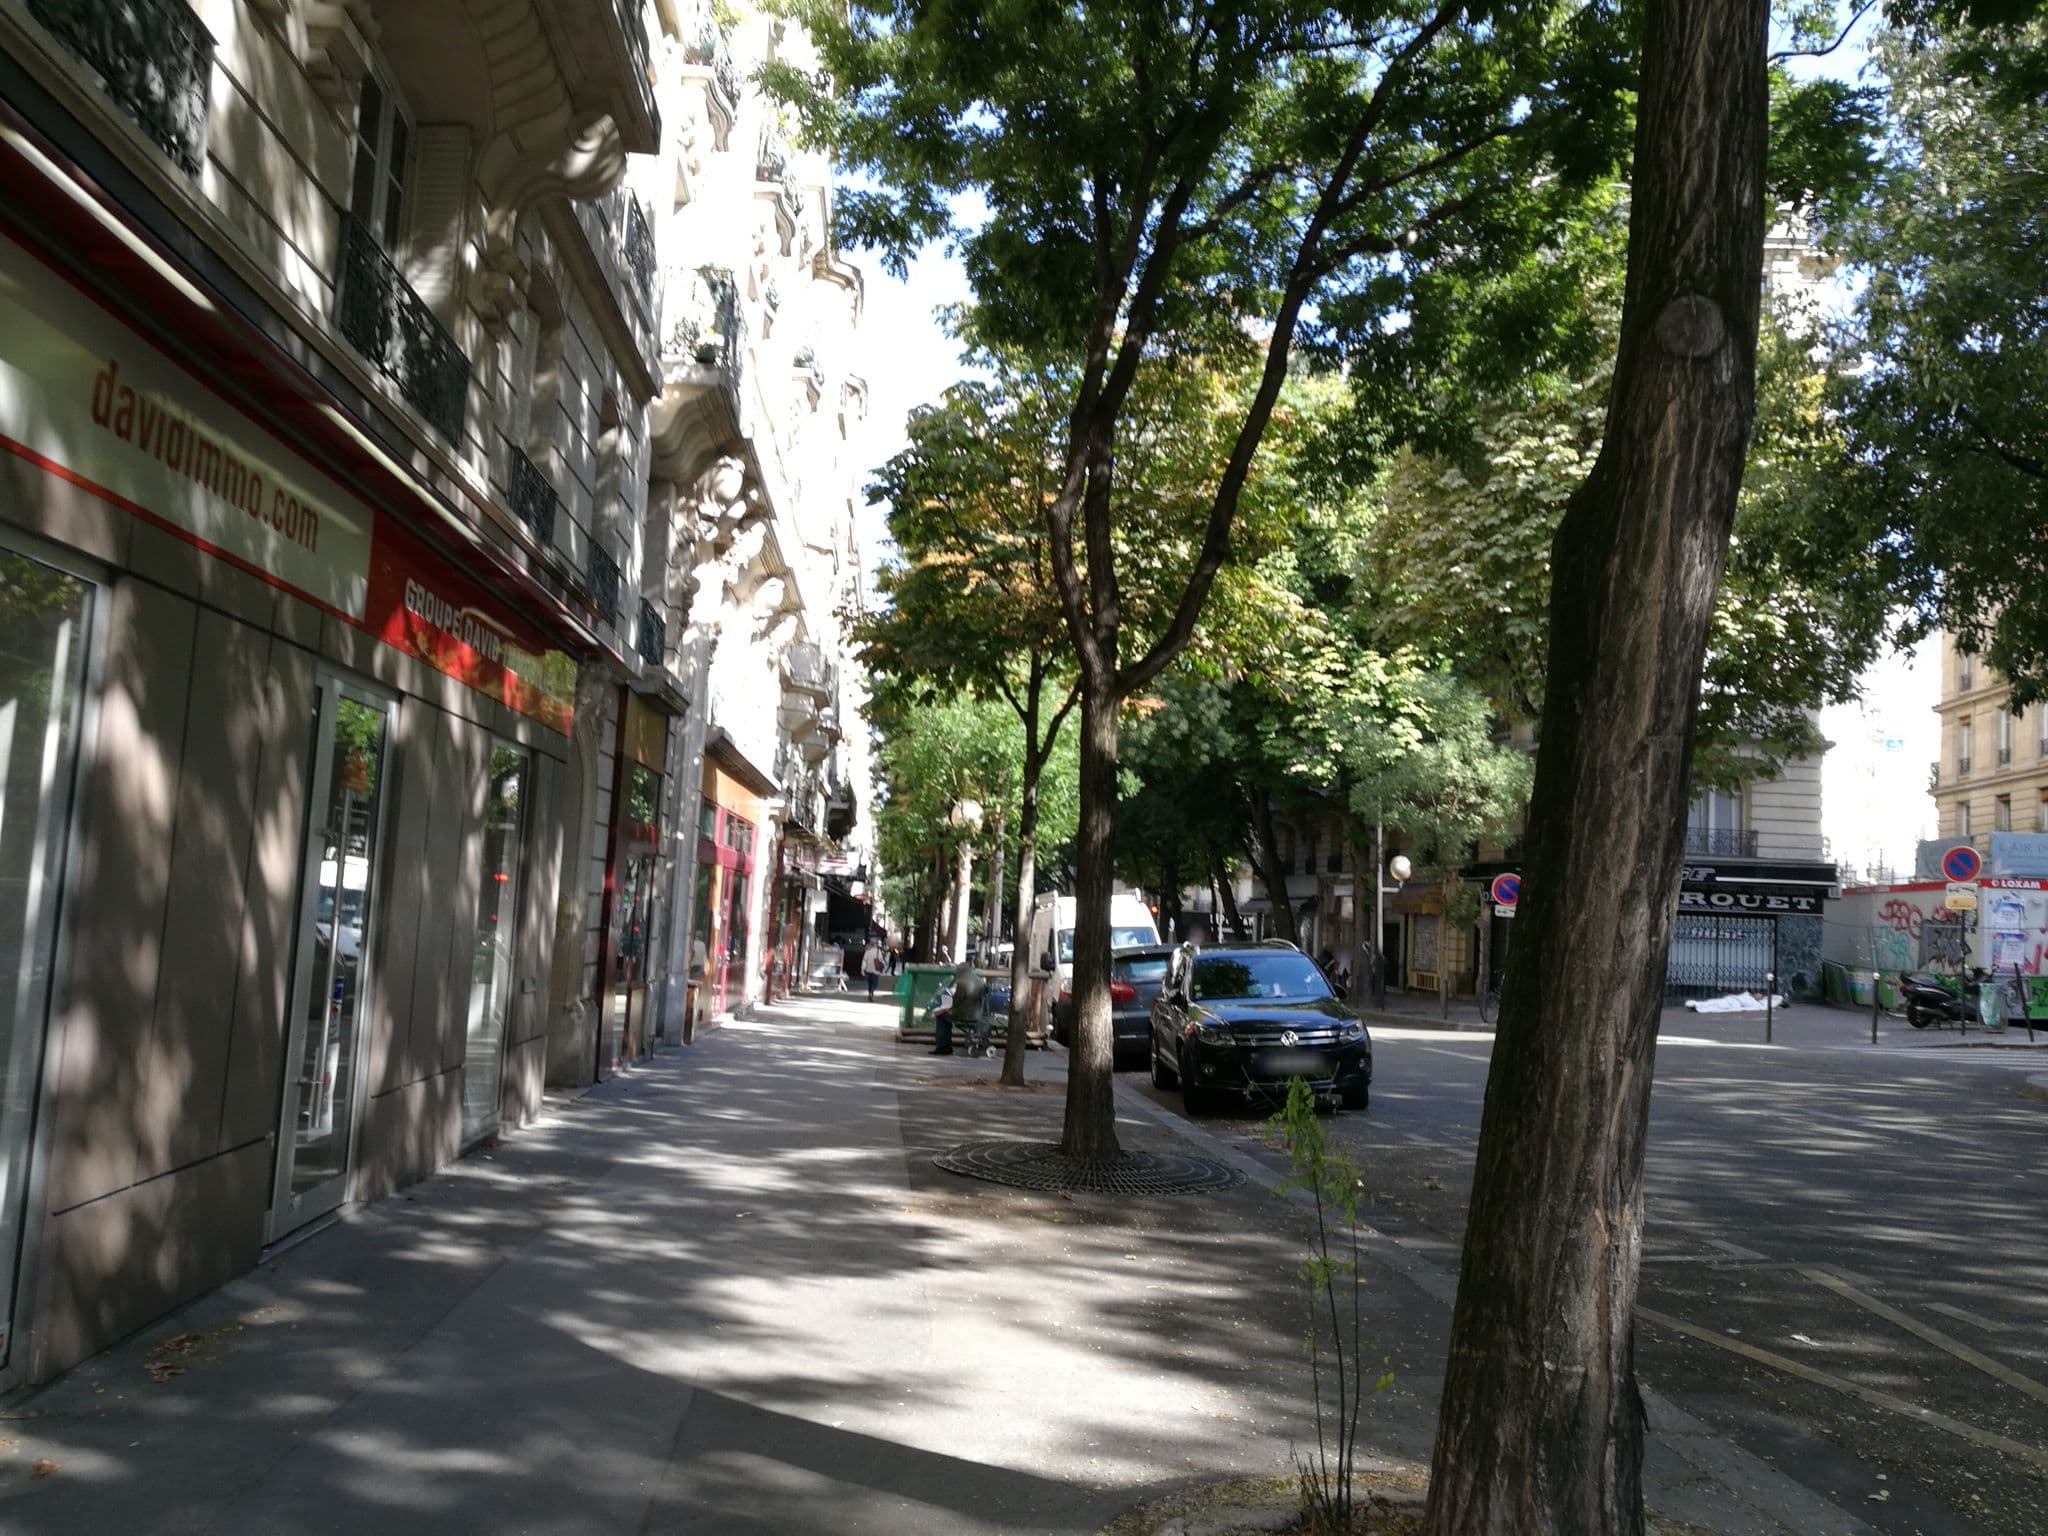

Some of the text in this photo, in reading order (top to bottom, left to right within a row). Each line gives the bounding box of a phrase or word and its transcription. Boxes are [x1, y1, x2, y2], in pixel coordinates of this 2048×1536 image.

[405, 577, 499, 662] GROUPE DAVID
[2001, 880, 2041, 889] LOXAM
